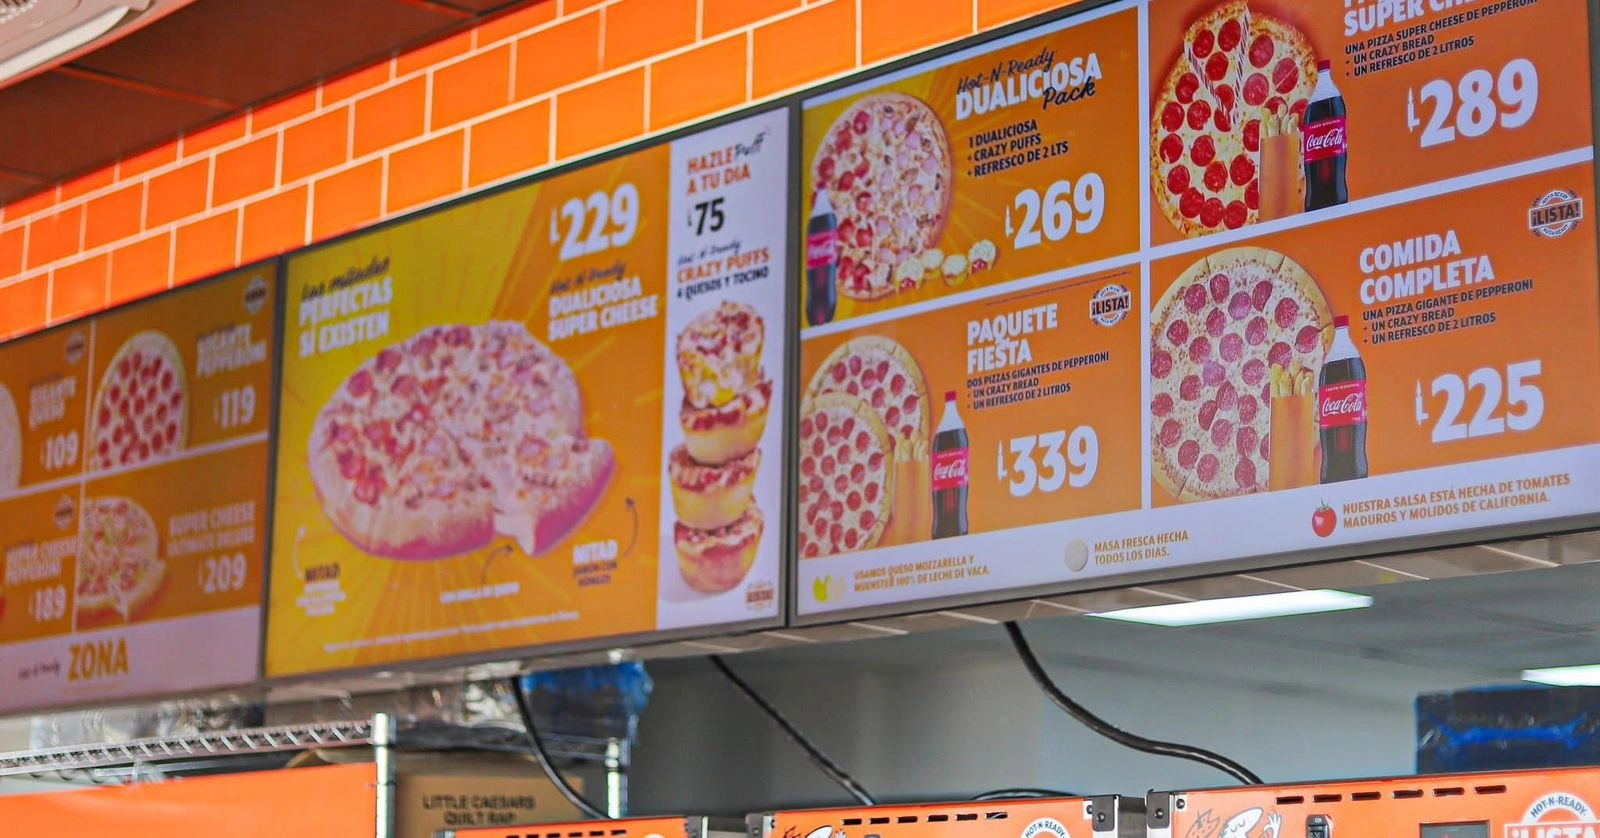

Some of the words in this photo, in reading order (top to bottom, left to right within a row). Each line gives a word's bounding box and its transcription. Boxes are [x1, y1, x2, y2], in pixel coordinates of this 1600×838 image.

[1344, 0, 1425, 37] SUPER
[1346, 42, 1365, 55] UNA
[1368, 33, 1394, 48] PIZZA
[1396, 24, 1427, 40] SUPER
[1429, 13, 1464, 31] CHEESE
[1467, 9, 1480, 21] DE
[1354, 52, 1367, 64] UN
[1369, 44, 1400, 60] CRAZY
[1402, 35, 1435, 51] BREAD
[1354, 65, 1367, 77] UN
[1370, 52, 1416, 73] REFRESCO
[1418, 48, 1431, 59] DE
[1432, 46, 1438, 55] 2
[1440, 36, 1475, 53] LITROS
[956, 52, 1103, 121] DUALICIOSA
[1042, 76, 1096, 110] Pack
[974, 142, 1008, 162] CRAZY
[1010, 133, 1042, 152] PUFFS
[975, 119, 1038, 147] DUALICIOSA
[687, 144, 735, 175] HAZLE
[974, 153, 1025, 177] REFRESCO
[1027, 149, 1041, 163] DE
[1043, 147, 1049, 158] 2
[1051, 141, 1069, 157] LTS
[687, 179, 697, 196] A
[702, 171, 720, 191] TU
[677, 260, 723, 284] CRAZY
[727, 247, 770, 271] PUFFS
[1359, 230, 1462, 274] COMIDA
[549, 277, 643, 318] DUALICIOSA
[1360, 255, 1496, 305] COMPLETA
[299, 277, 394, 327] PERFECTAS
[1363, 309, 1384, 321] UNA
[1385, 303, 1414, 317] PIZZA
[1416, 294, 1459, 311] GIGANTE
[1461, 291, 1474, 302] DE
[1475, 279, 1533, 300] PEPPERONI
[549, 309, 599, 341] SUPER
[600, 295, 659, 329] CHEESE
[967, 303, 1059, 346] PAQUETE
[1372, 320, 1386, 332] UN
[1387, 314, 1419, 329] CRAZY
[1421, 307, 1455, 323] BREAD
[1372, 333, 1386, 345] UN
[1388, 324, 1436, 343] REFRESCO
[1438, 321, 1451, 332] DE
[1452, 319, 1459, 329] 2
[1460, 312, 1497, 329] LITROS
[967, 339, 1033, 374] FIESTA
[967, 378, 983, 389] DOS
[984, 372, 1011, 386] PIZZAS
[1012, 364, 1051, 381] GIGANTES
[1052, 361, 1063, 372] DE
[1064, 351, 1110, 370] PEPPERONI
[973, 388, 985, 399] UN
[986, 383, 1012, 397] CRAZY
[1013, 377, 1040, 392] BREAD
[973, 399, 986, 410] UN
[986, 393, 1024, 408] REFRESCO
[1026, 390, 1037, 400] DE
[1038, 389, 1043, 398] 2
[1043, 382, 1071, 397] LITROS
[1343, 497, 1391, 515] NUESTRA
[1393, 492, 1428, 508] SALSA
[1458, 483, 1497, 500] HECHA
[1499, 481, 1514, 493] DE
[1516, 473, 1571, 490] TOMATES
[1343, 512, 1398, 529] MADUROS
[1399, 510, 1407, 521] Y
[1410, 503, 1460, 520] MOLIDOS
[1463, 500, 1477, 513] DE
[1479, 492, 1551, 511] CALIFORNIA.
[1094, 540, 1121, 553] MASA
[1122, 535, 1156, 549] FRESCA
[1157, 530, 1189, 545] HECHA
[1095, 552, 1125, 566] TODOS
[1126, 549, 1143, 561] LOS
[854, 566, 887, 581] USAMOS
[888, 564, 914, 577] QUESO
[915, 557, 967, 573] MOZZARELLA
[969, 554, 975, 565] Y
[917, 573, 928, 583] DE
[929, 570, 953, 582] LECHE
[955, 567, 965, 578] DE
[68, 637, 129, 682] ZONA
[422, 795, 466, 810] LITTLE
[1531, 795, 1587, 817] HOT-N-READY
